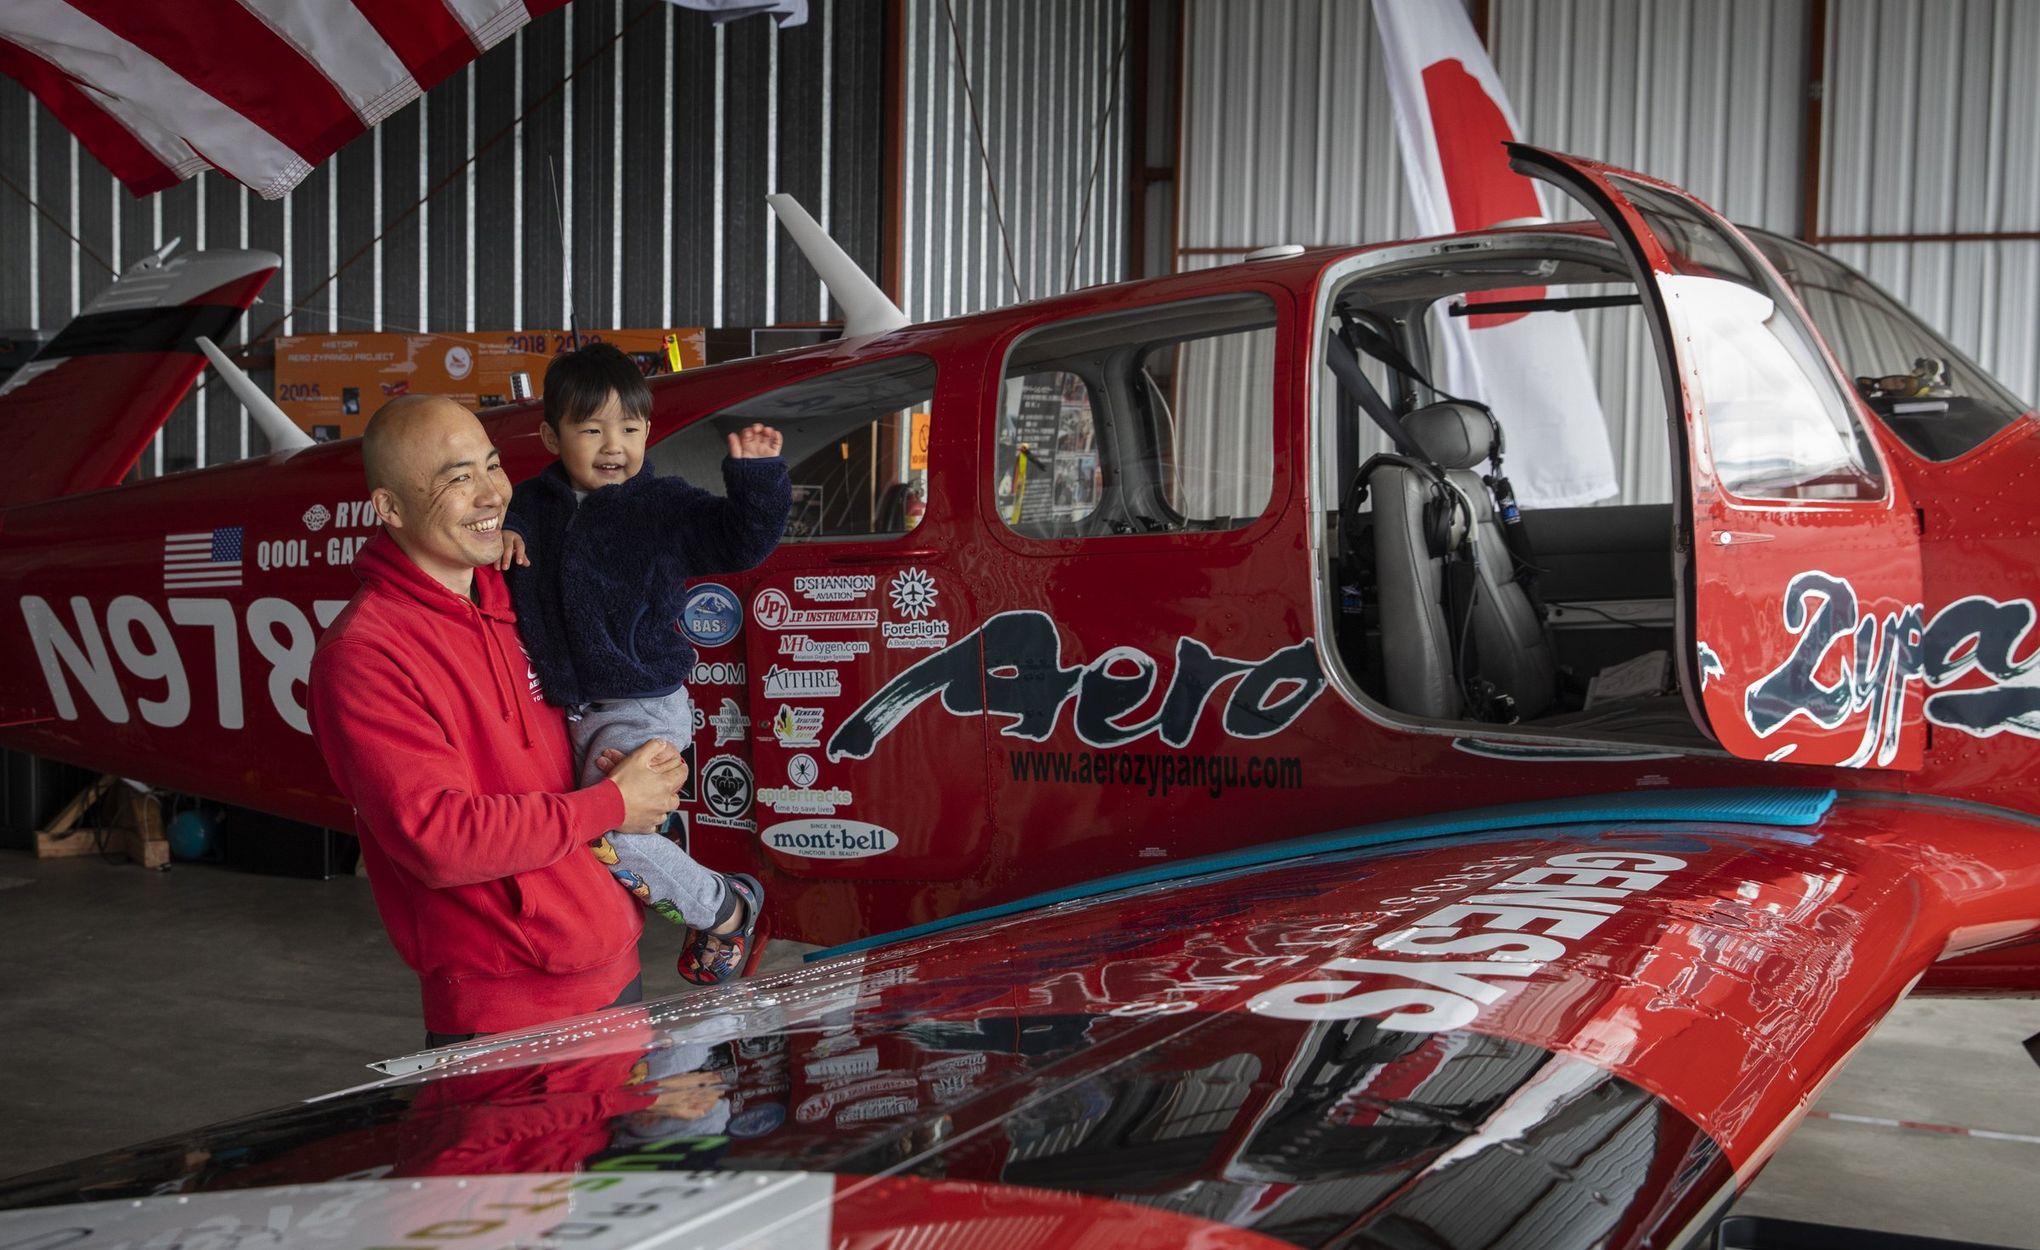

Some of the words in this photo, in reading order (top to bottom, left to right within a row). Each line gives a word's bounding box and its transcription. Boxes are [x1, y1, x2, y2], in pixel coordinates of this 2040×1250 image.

[506, 336, 546, 353] 2018
[279, 384, 322, 401] 2005
[257, 539, 310, 571] QOOL
[795, 576, 875, 591] D'SHANNON
[816, 591, 853, 600] AVIATION
[806, 610, 877, 622] INSTRUMENTS
[693, 619, 721, 632] BAS
[883, 621, 947, 636] ForeFlight
[1010, 751, 1303, 799] www.aerozypangu.com
[758, 787, 851, 805] spidertracks
[775, 804, 790, 812] time
[818, 805, 834, 813] lives
[697, 815, 727, 826] Misawa
[729, 818, 757, 833] Family
[1246, 851, 1690, 1034] GENESYS
